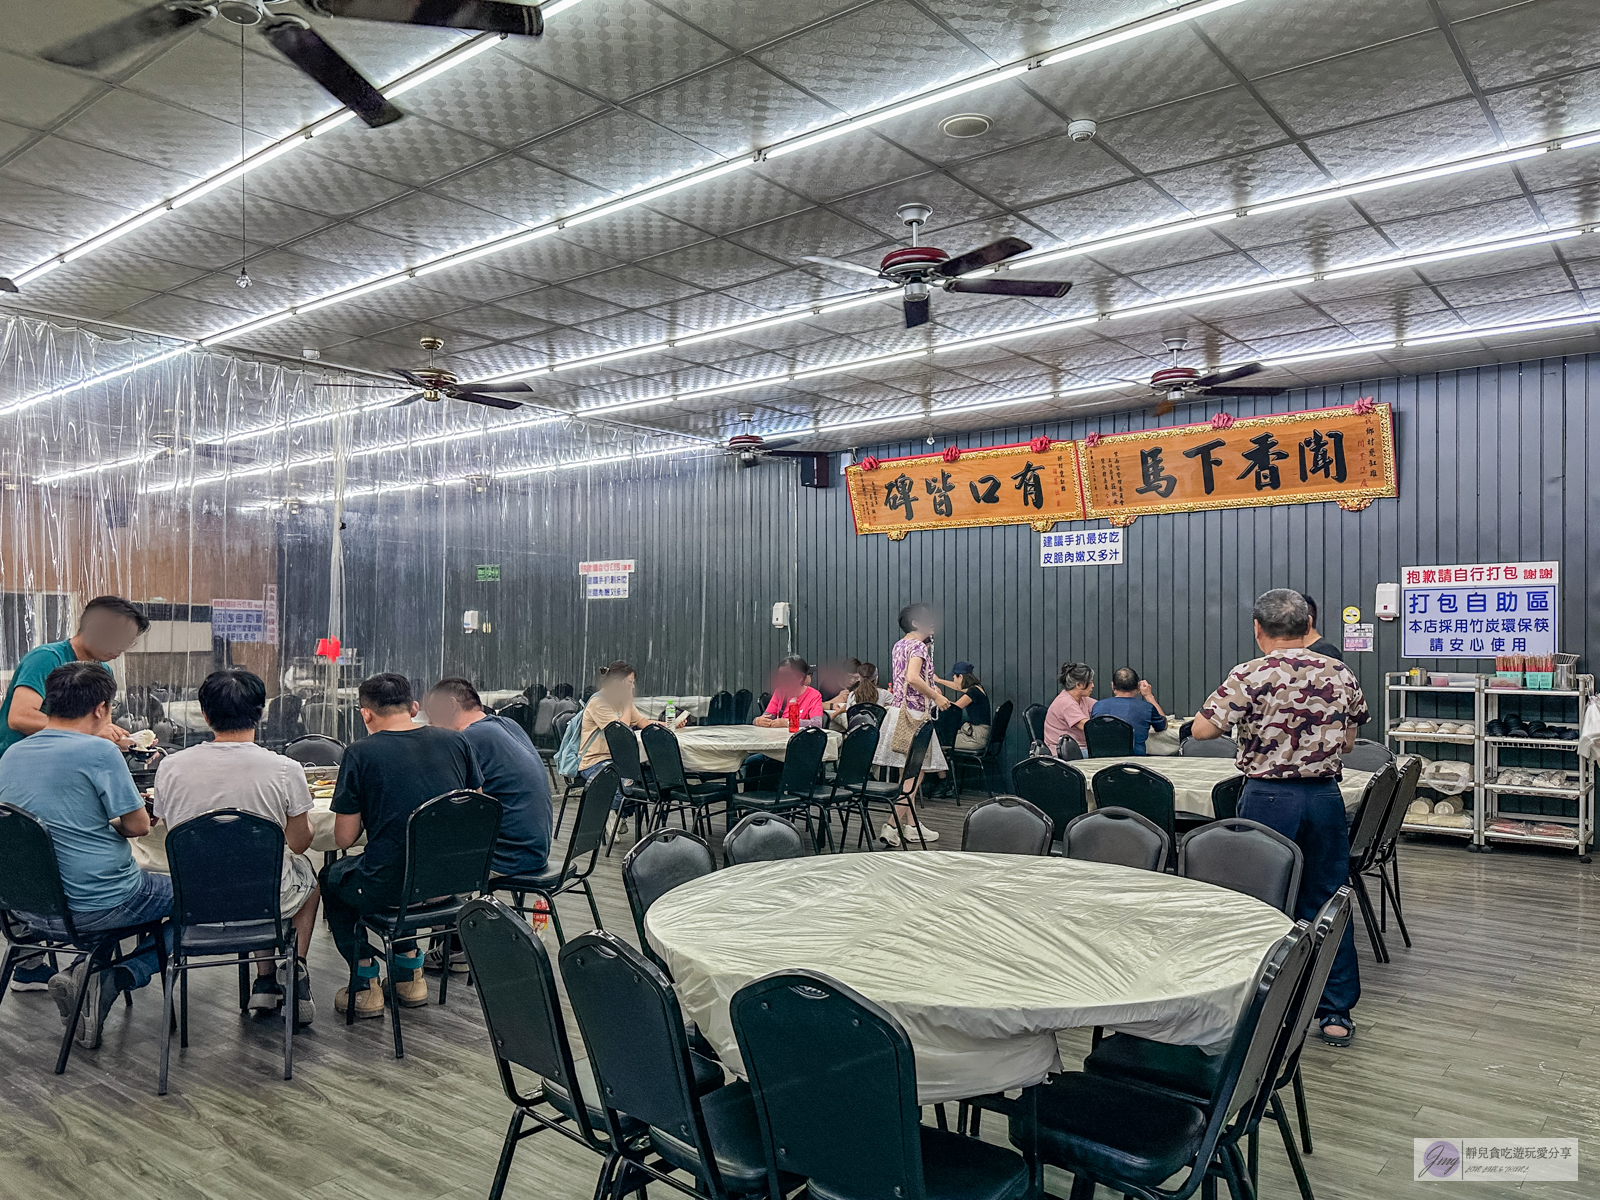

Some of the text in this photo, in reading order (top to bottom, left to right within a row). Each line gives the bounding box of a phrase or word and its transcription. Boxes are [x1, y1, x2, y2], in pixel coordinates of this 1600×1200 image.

[1043, 531, 1120, 548] 建議手扒最好吃
[1043, 548, 1120, 564] 皮脆肉嫩又多汁
[1406, 565, 1553, 585] 抱歉請自行打包 謝謝
[1409, 591, 1550, 615] 打包自助區
[1408, 618, 1550, 634] 本店採用竹炭環保筷
[1429, 637, 1527, 653] 請安心使用
